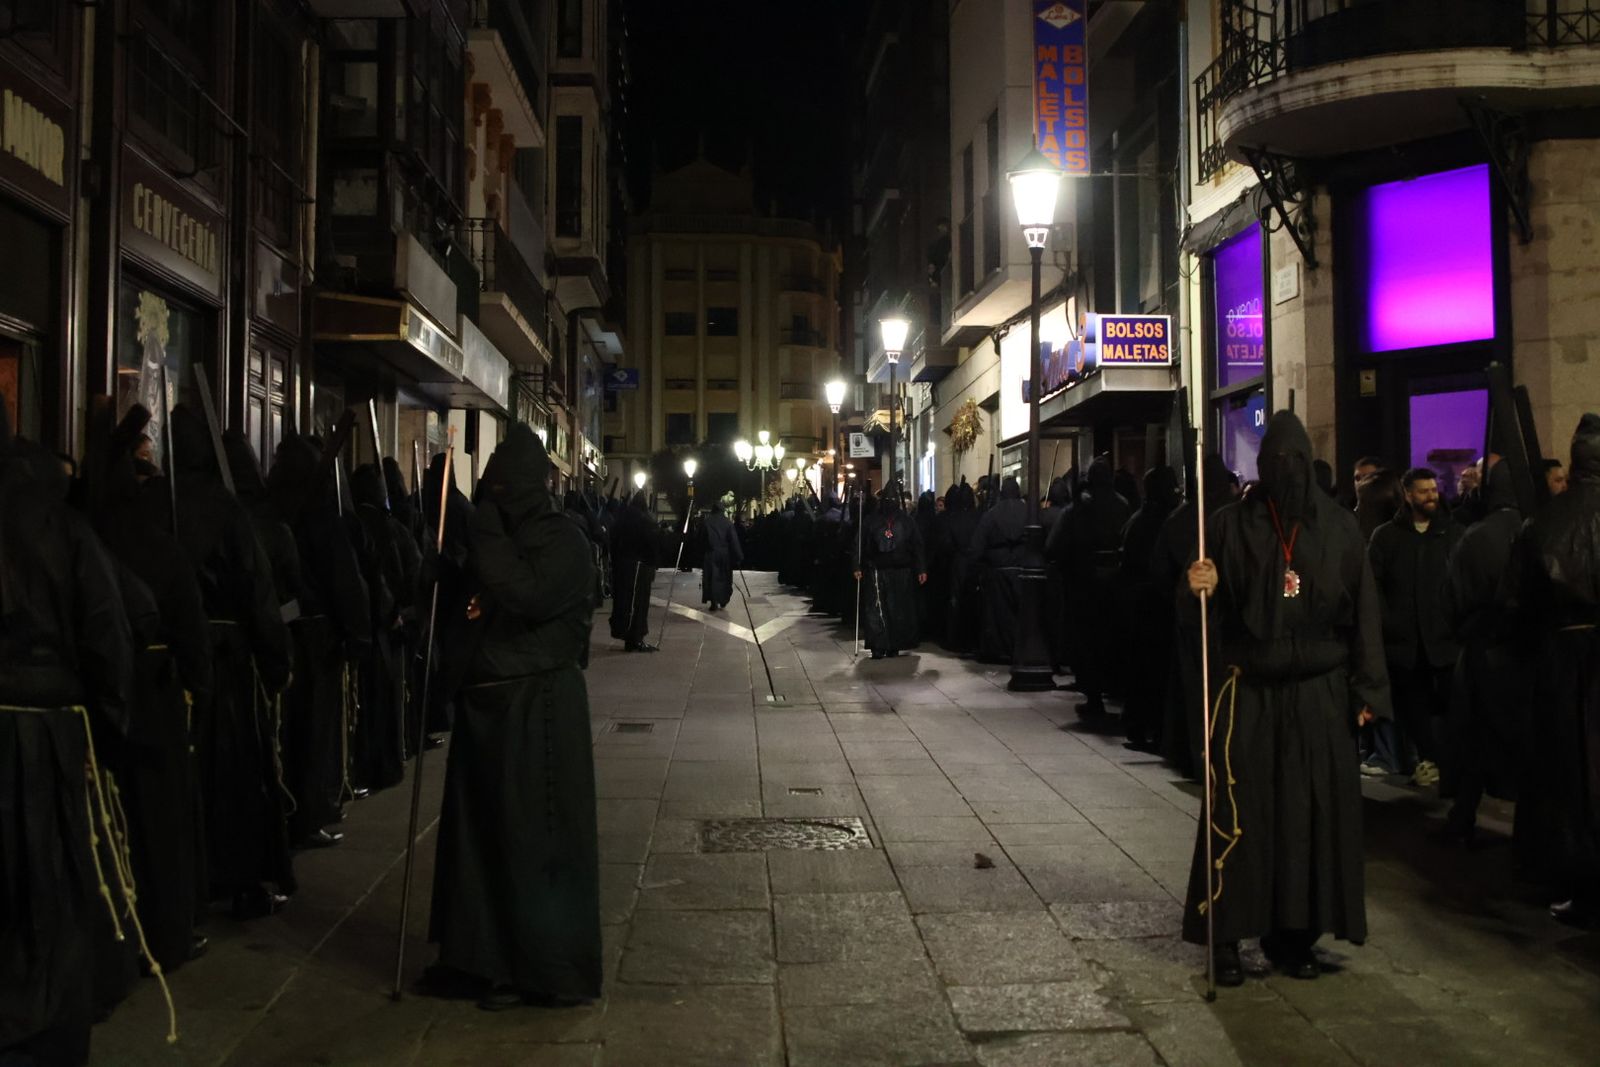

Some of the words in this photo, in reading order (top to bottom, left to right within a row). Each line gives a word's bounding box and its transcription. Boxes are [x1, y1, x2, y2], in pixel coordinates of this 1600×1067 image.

[1063, 44, 1086, 170] BOLSOS
[133, 182, 215, 275] CERVECERÍA
[1102, 343, 1168, 360] MALETAS
[1105, 321, 1164, 339] BOLSOS
